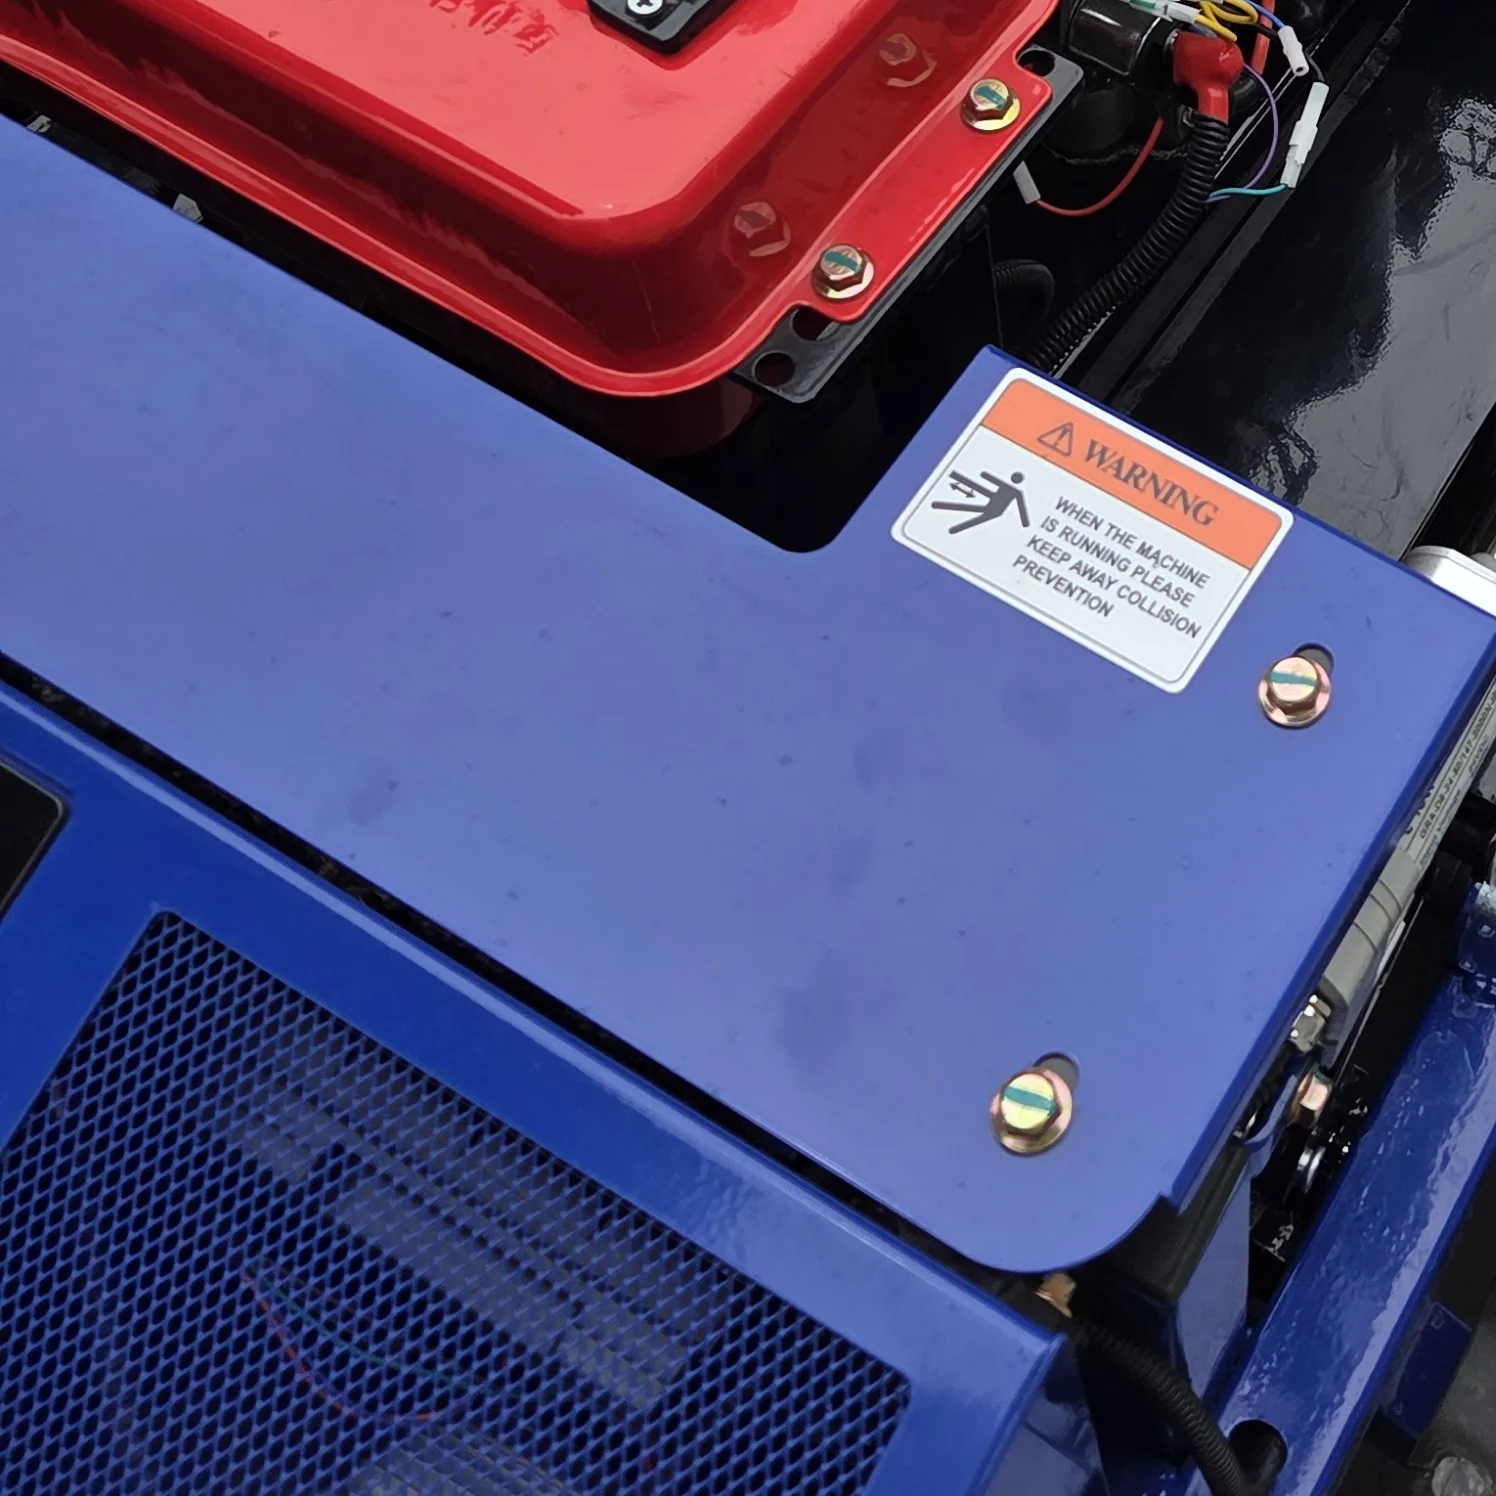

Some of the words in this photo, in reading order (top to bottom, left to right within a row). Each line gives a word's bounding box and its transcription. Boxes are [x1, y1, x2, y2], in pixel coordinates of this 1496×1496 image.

[1085, 440, 1218, 526] WARNING
[1013, 556, 1113, 617] PREVENTION
[1027, 536, 1071, 567] KEEP
[1069, 559, 1117, 591] AWAY
[1117, 584, 1201, 638] COLLISION
[1041, 516, 1059, 533] IS
[1059, 526, 1129, 573] RUNNING
[1131, 564, 1195, 607] PLEASE
[1056, 497, 1103, 531] WHEN
[1104, 521, 1137, 548] THE
[1137, 539, 1210, 589] MACHINE
